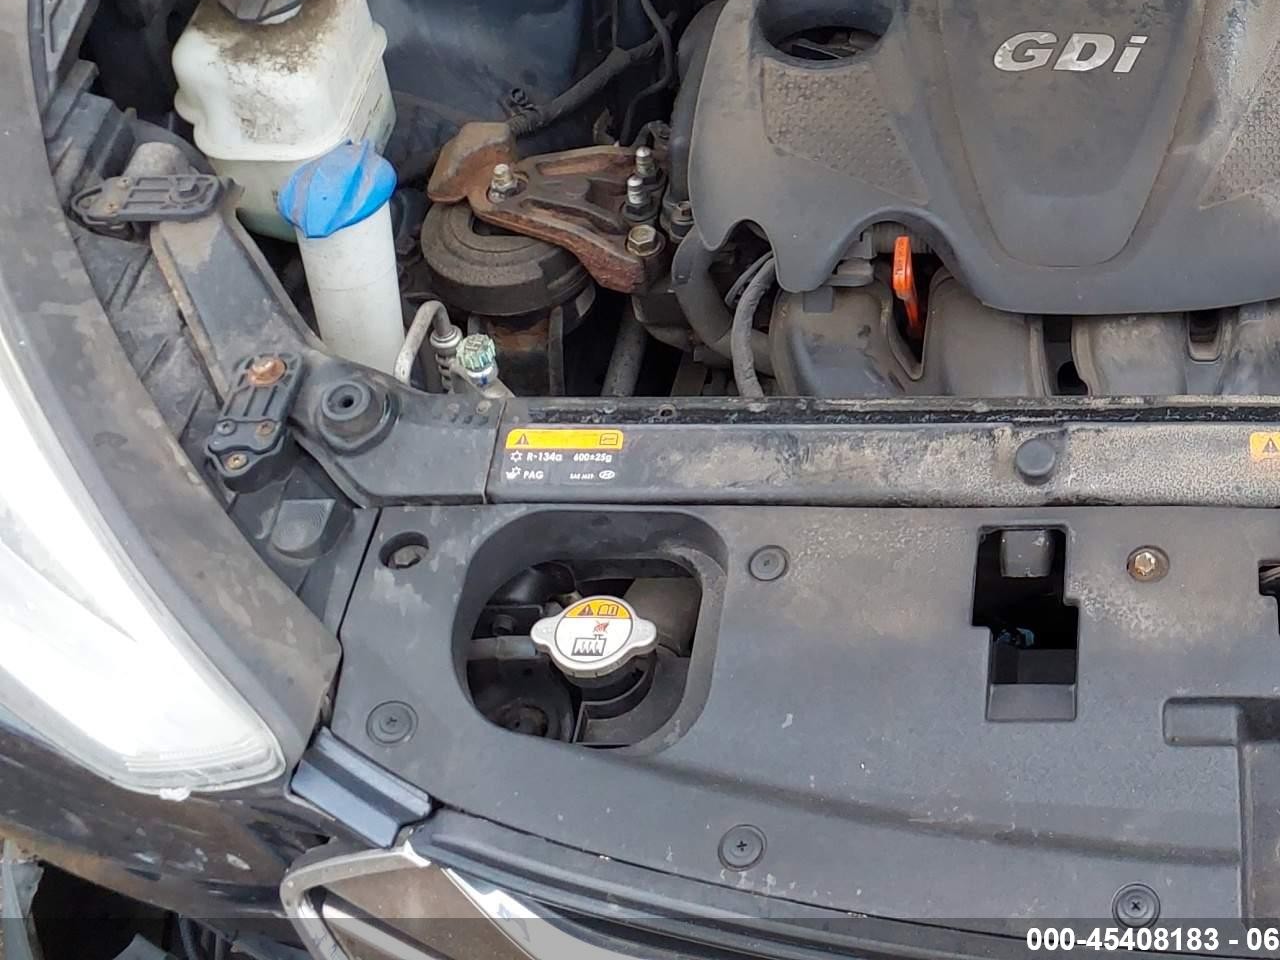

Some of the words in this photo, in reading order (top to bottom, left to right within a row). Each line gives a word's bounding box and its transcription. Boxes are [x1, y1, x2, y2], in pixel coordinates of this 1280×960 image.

[993, 31, 1149, 73] GDi
[526, 452, 562, 461] R-134a
[523, 470, 543, 479] PAG
